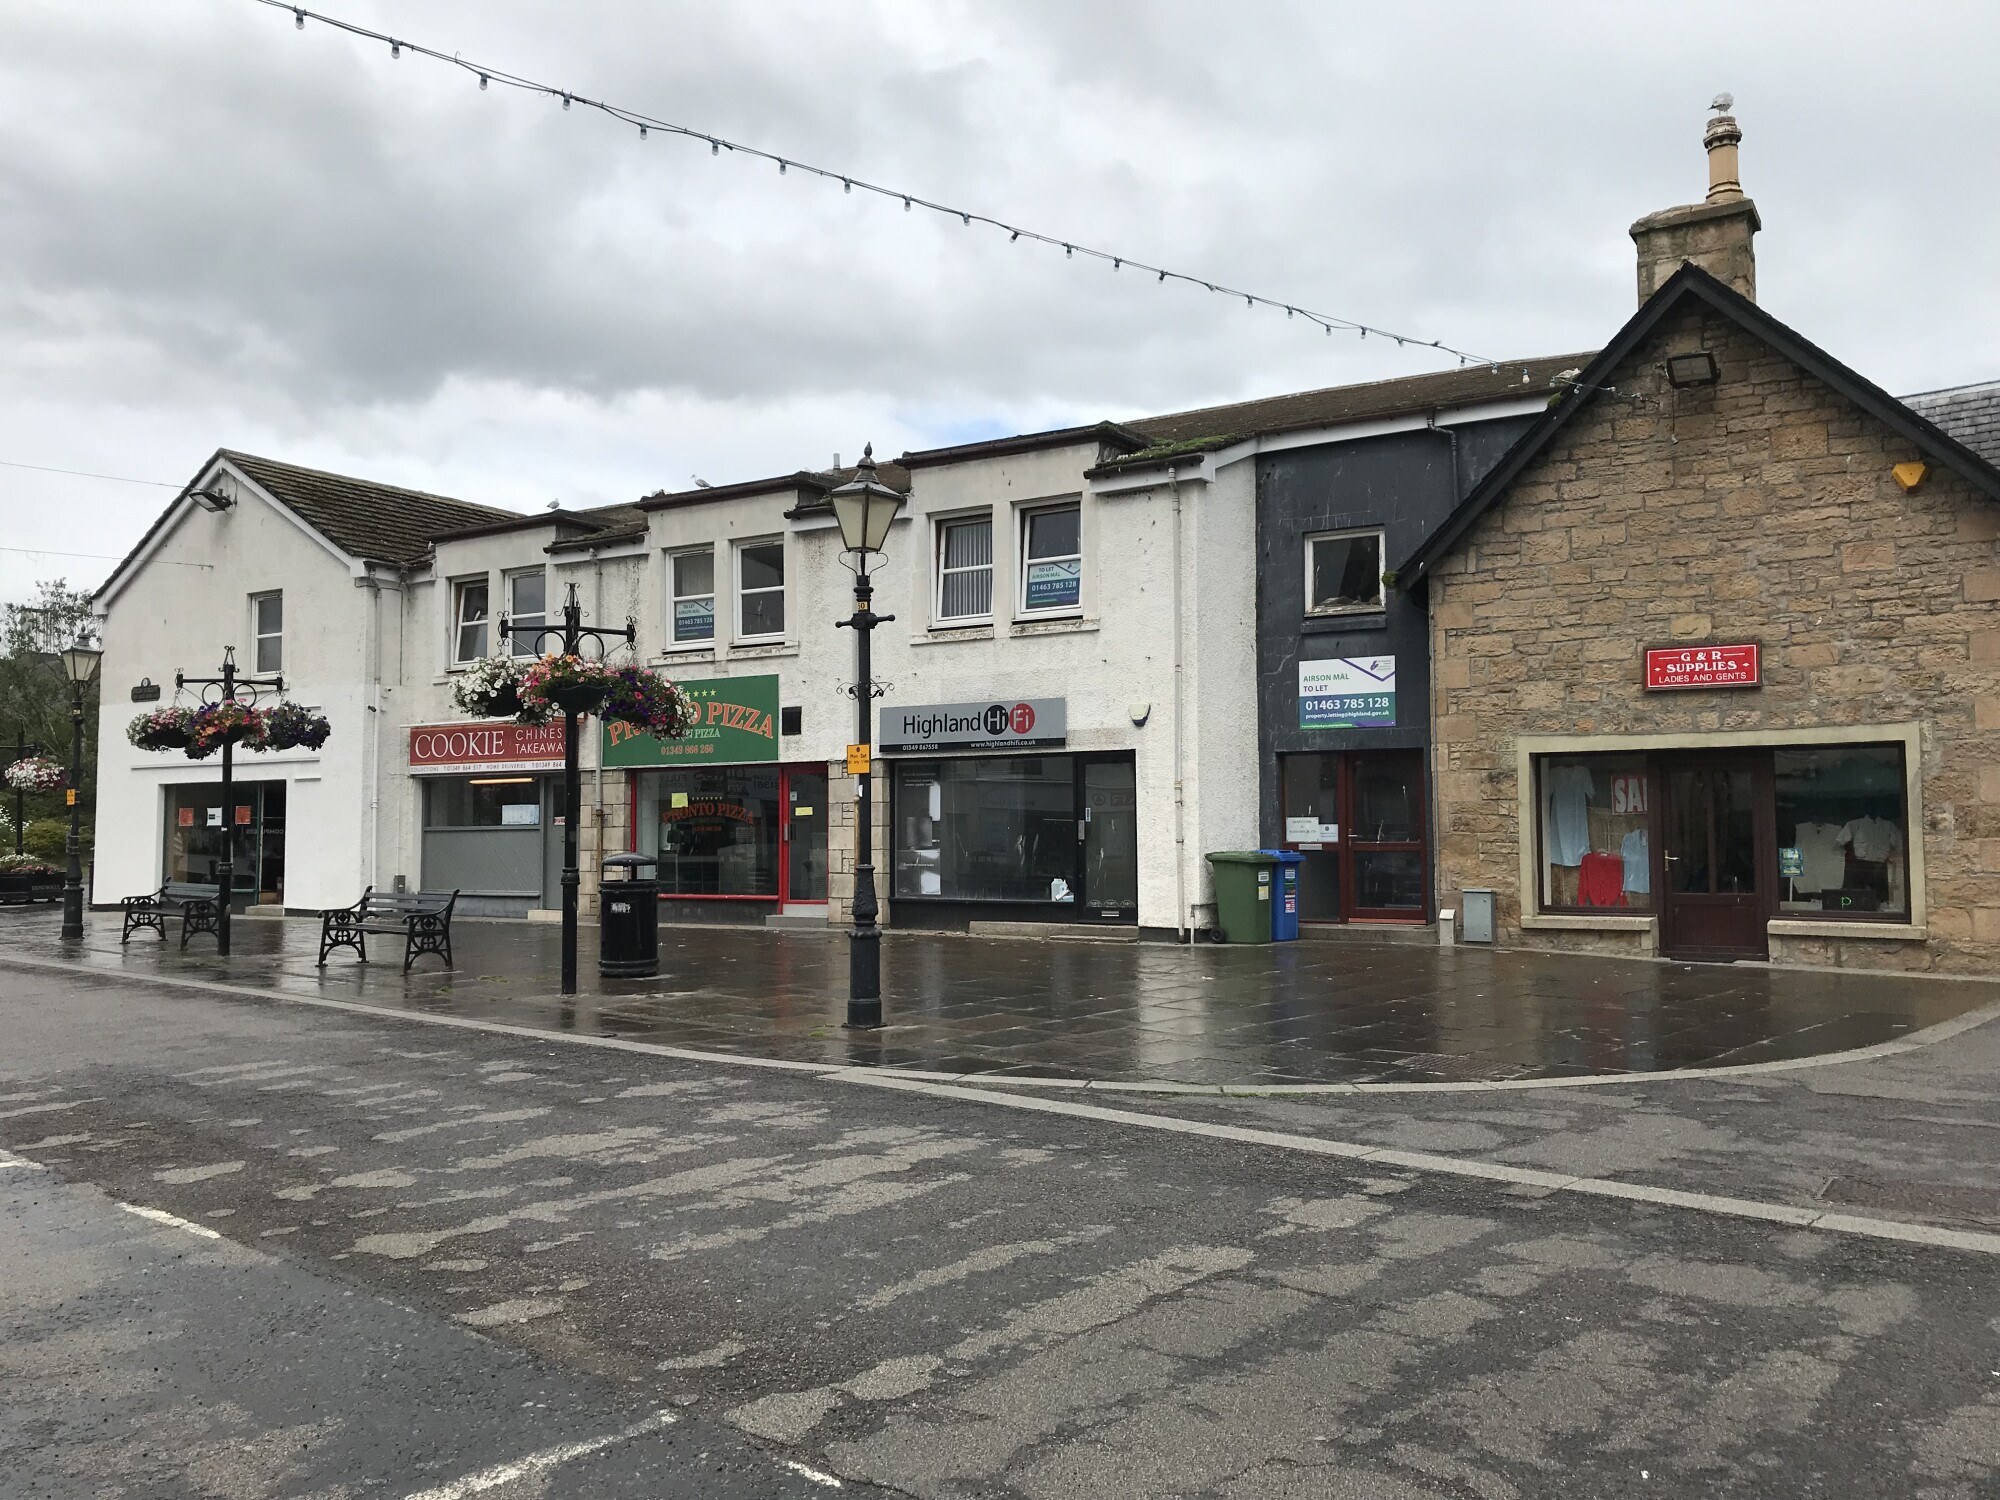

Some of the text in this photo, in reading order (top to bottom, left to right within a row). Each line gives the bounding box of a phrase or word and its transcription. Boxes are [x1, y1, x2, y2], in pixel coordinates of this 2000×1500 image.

[1680, 651, 1722, 661] G & R
[1666, 660, 1737, 673] SUPPLIES
[1303, 674, 1332, 682] AIRSON
[1658, 671, 1747, 683] LADIES AND GENTS
[1315, 684, 1328, 692] LET
[1305, 697, 1389, 711] 01463 785 128
[706, 702, 774, 739] PIZZA
[903, 711, 981, 739] Highland
[515, 728, 563, 741] CHINES
[694, 728, 721, 739] PIZZA
[415, 731, 505, 758] COOKIE
[515, 741, 566, 754] TAKEAWA
[661, 745, 683, 755] 01349
[970, 739, 1036, 748] www.highlandhifi.co.uk
[662, 802, 754, 825] PRONTO PIZZA
